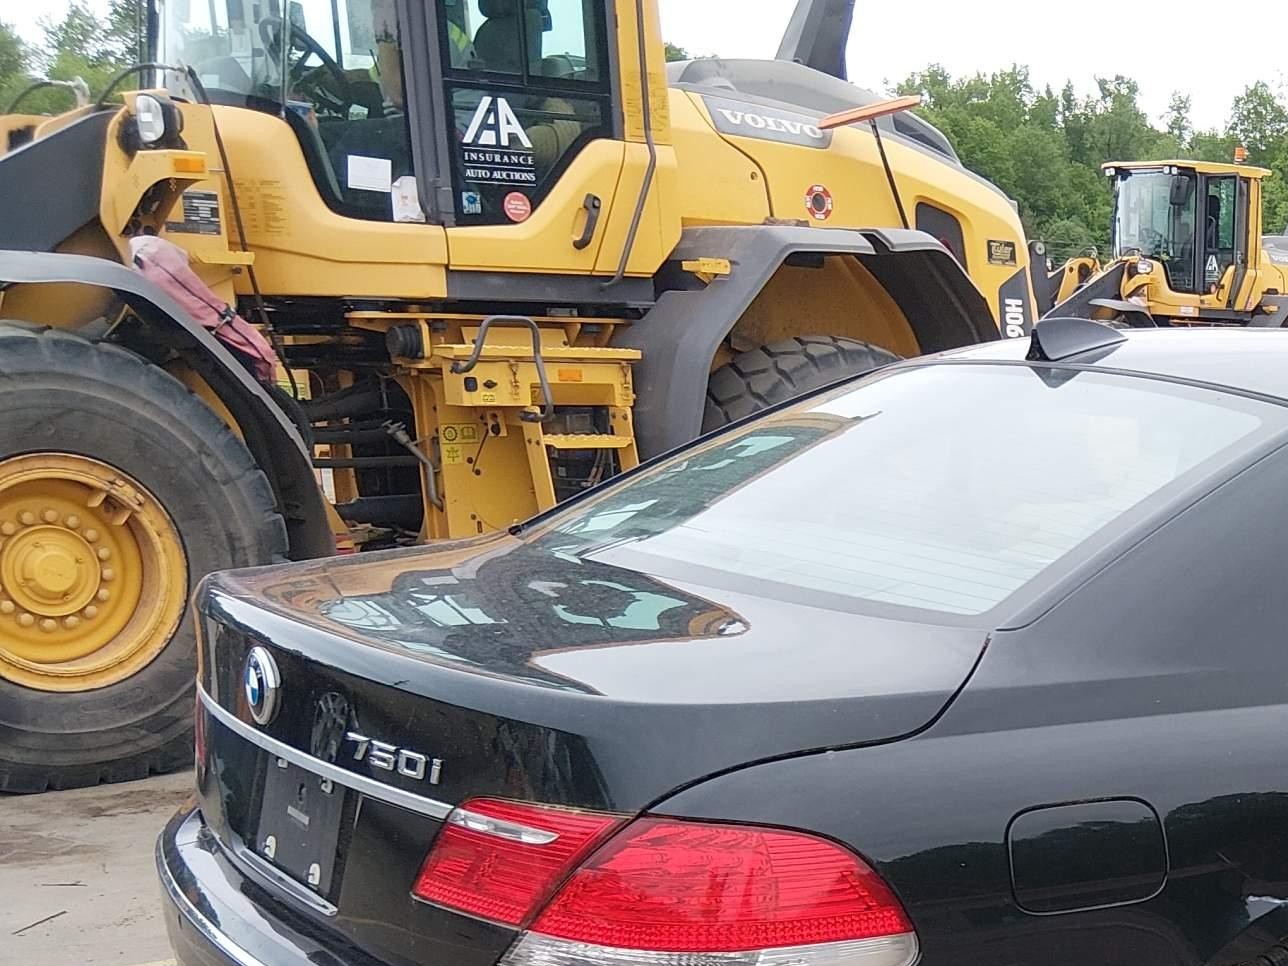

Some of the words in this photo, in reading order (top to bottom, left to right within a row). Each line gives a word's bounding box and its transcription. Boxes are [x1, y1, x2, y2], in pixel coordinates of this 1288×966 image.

[717, 108, 825, 139] VOLVO
[464, 151, 535, 165] INSURANCE
[465, 168, 490, 179] AUTO
[491, 171, 536, 182] AUCTIONS
[345, 731, 445, 785] 750i
